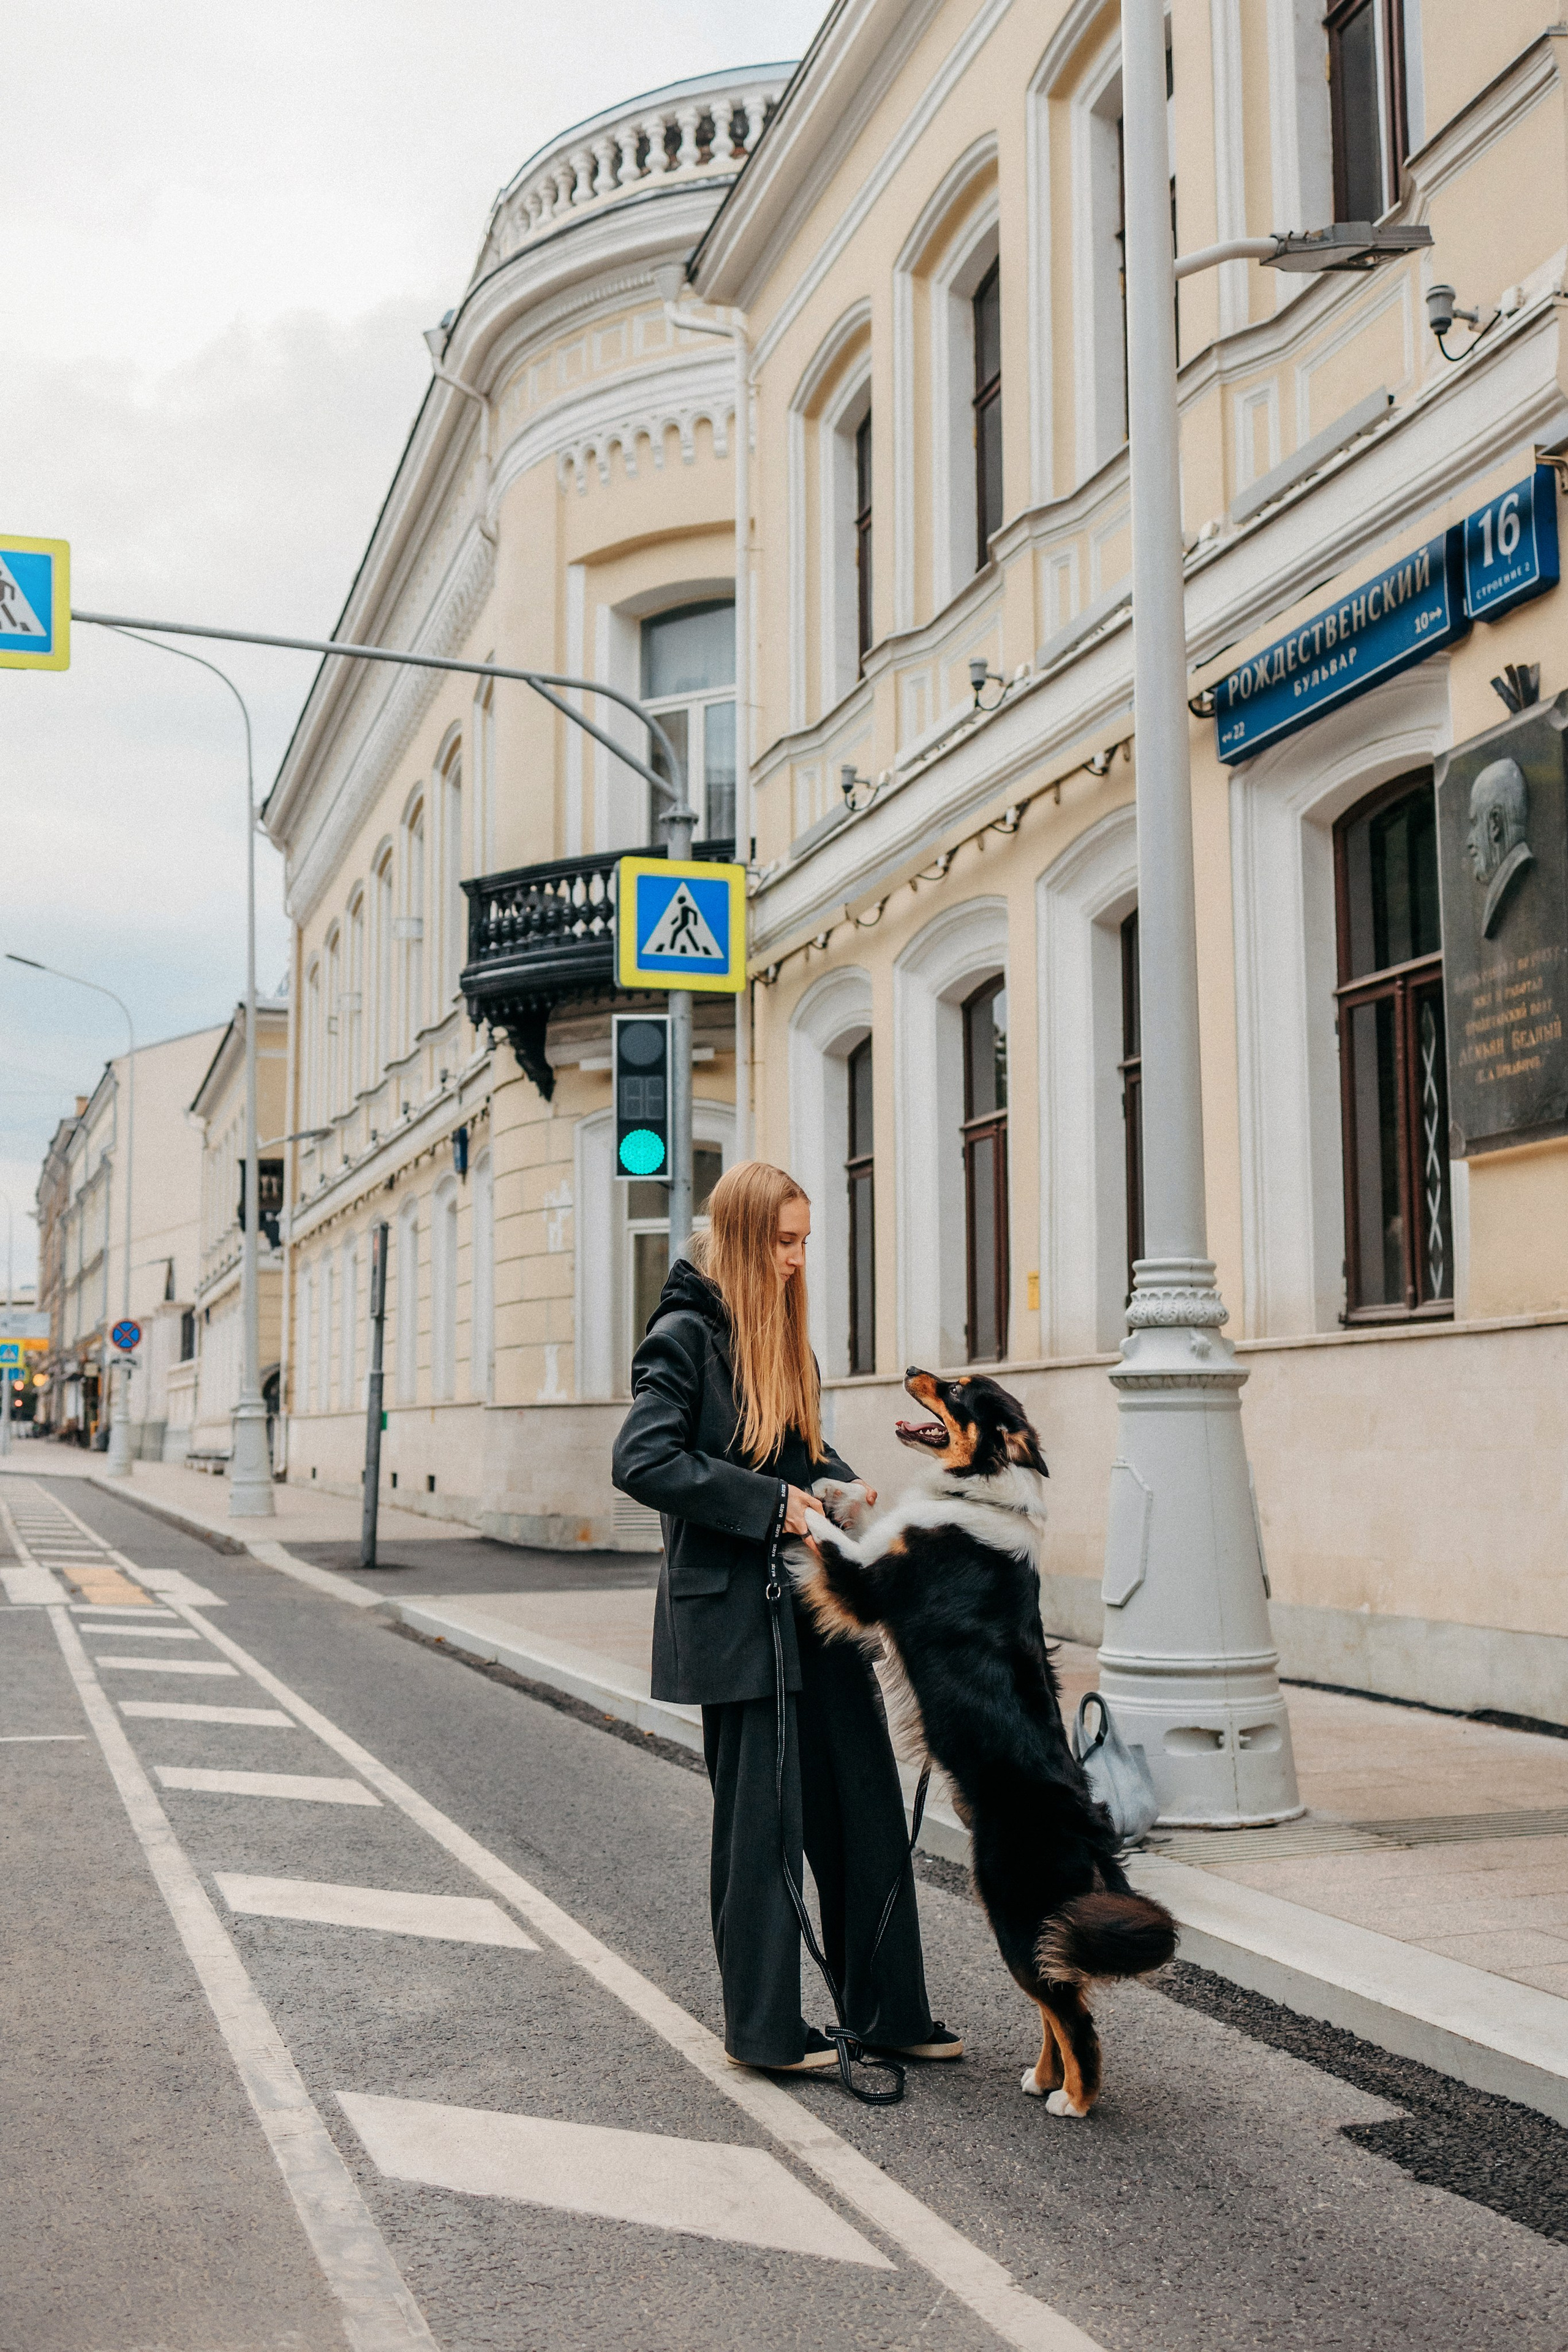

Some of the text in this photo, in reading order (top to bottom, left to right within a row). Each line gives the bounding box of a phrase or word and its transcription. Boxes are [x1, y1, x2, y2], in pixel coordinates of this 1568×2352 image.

[1478, 492, 1520, 568] 16
[1227, 546, 1430, 706] РОЖДЕСТВЕНСКИЙ
[1414, 610, 1429, 635] 10
[1294, 647, 1357, 697] БУЛЬВАР
[1233, 721, 1245, 740] 22
